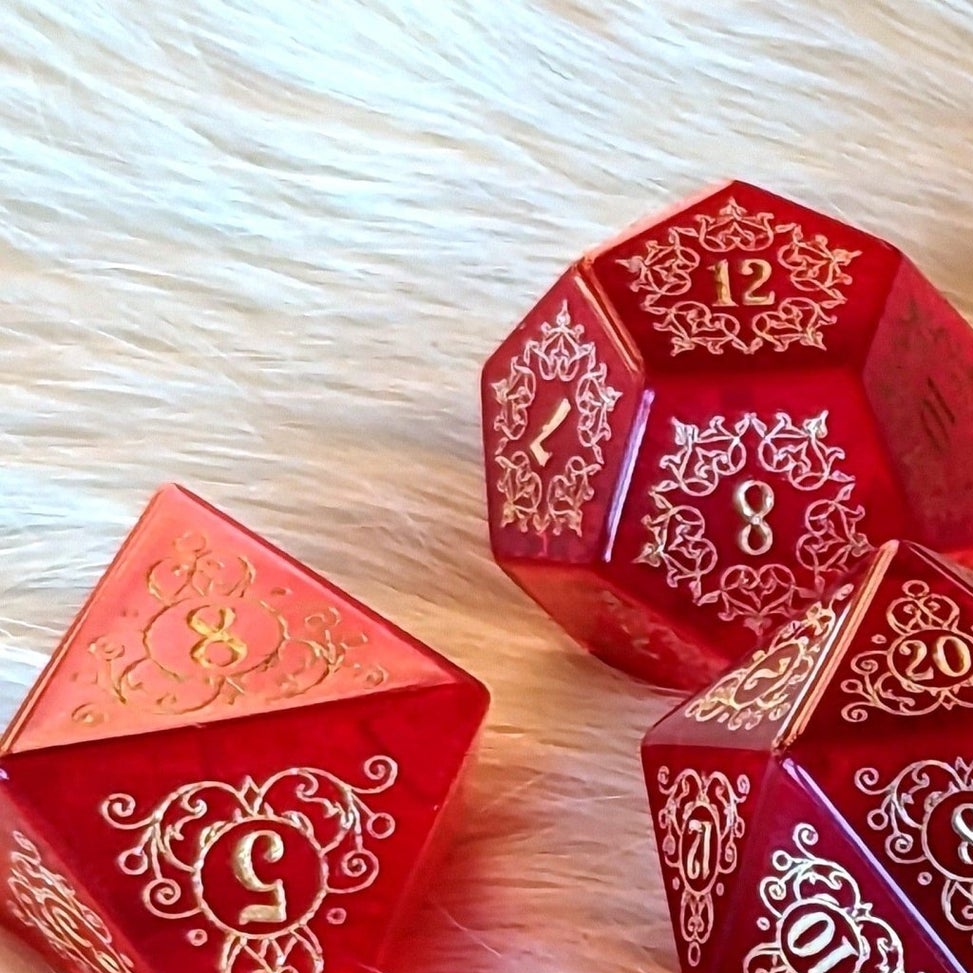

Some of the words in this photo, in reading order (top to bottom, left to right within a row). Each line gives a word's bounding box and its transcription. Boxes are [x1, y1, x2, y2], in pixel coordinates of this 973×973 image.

[713, 258, 776, 308] 12
[735, 479, 776, 557] 8
[186, 604, 248, 669] 8
[904, 636, 972, 679] 20
[231, 829, 288, 925] 5
